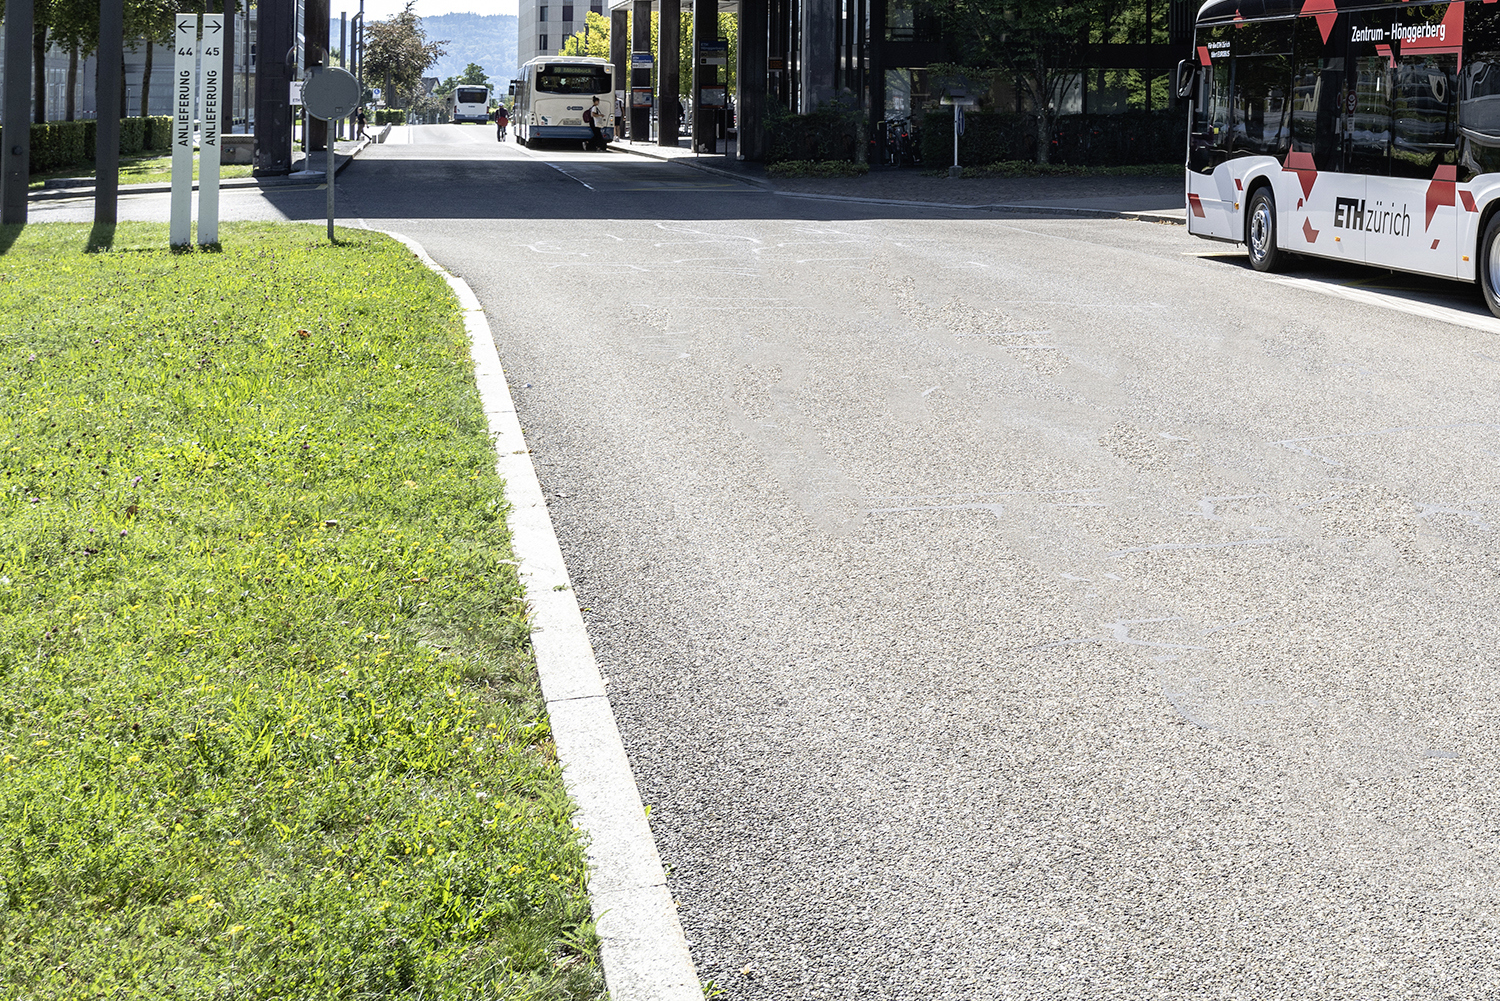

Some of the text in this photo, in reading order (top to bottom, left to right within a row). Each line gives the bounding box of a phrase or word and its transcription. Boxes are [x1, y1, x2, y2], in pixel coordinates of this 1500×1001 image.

[1351, 26, 1384, 42] Zentrum
[1391, 20, 1446, 43] Hönggerberg
[178, 47, 193, 56] 44
[205, 47, 220, 56] 45
[178, 70, 190, 147] ANLIEFERUNG
[205, 70, 217, 147] ANLIEFERUNG
